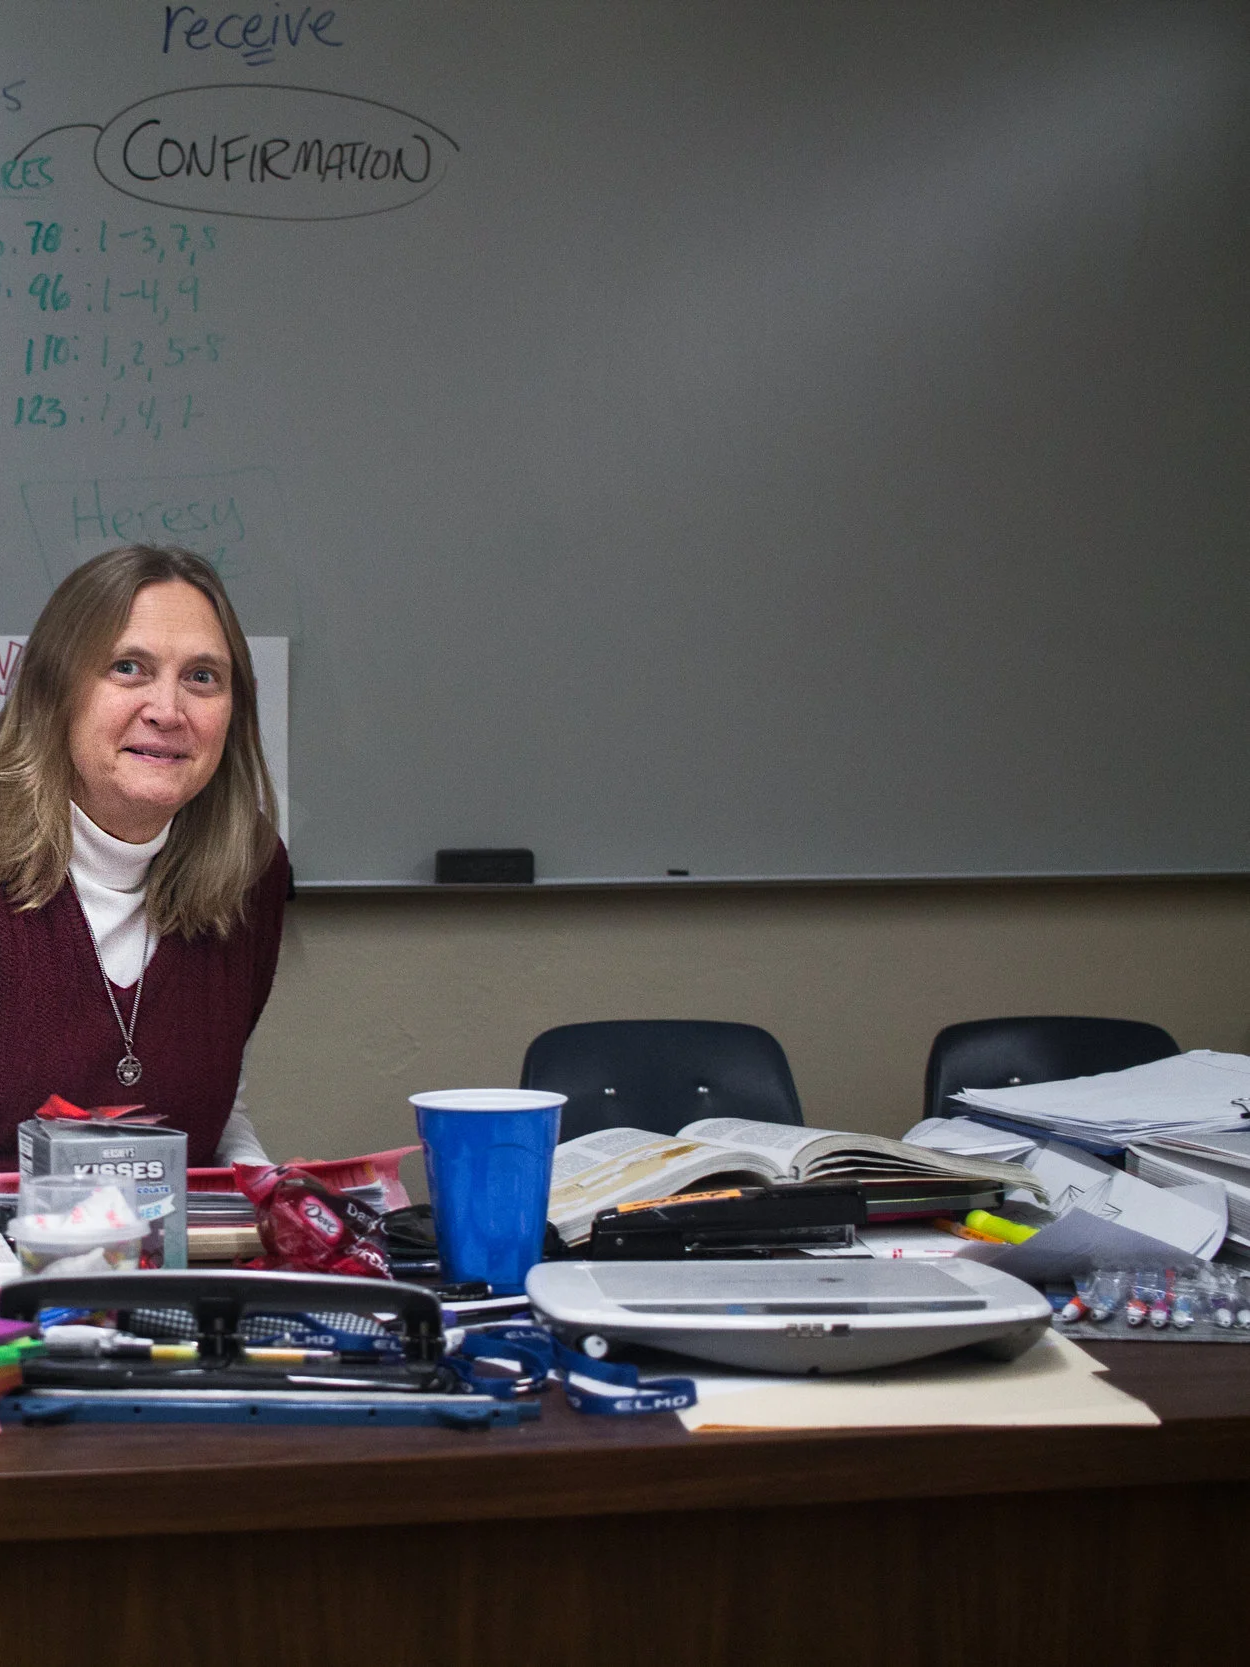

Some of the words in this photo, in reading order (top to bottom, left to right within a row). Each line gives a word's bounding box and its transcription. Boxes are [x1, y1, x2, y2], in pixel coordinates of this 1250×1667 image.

[162, 5, 345, 54] receive
[123, 119, 432, 184] CONFIRMATION
[71, 479, 246, 544] Heresy
[73, 1161, 165, 1181] KISSES
[137, 1186, 171, 1194] COLATE
[614, 1395, 689, 1412] ELMO
